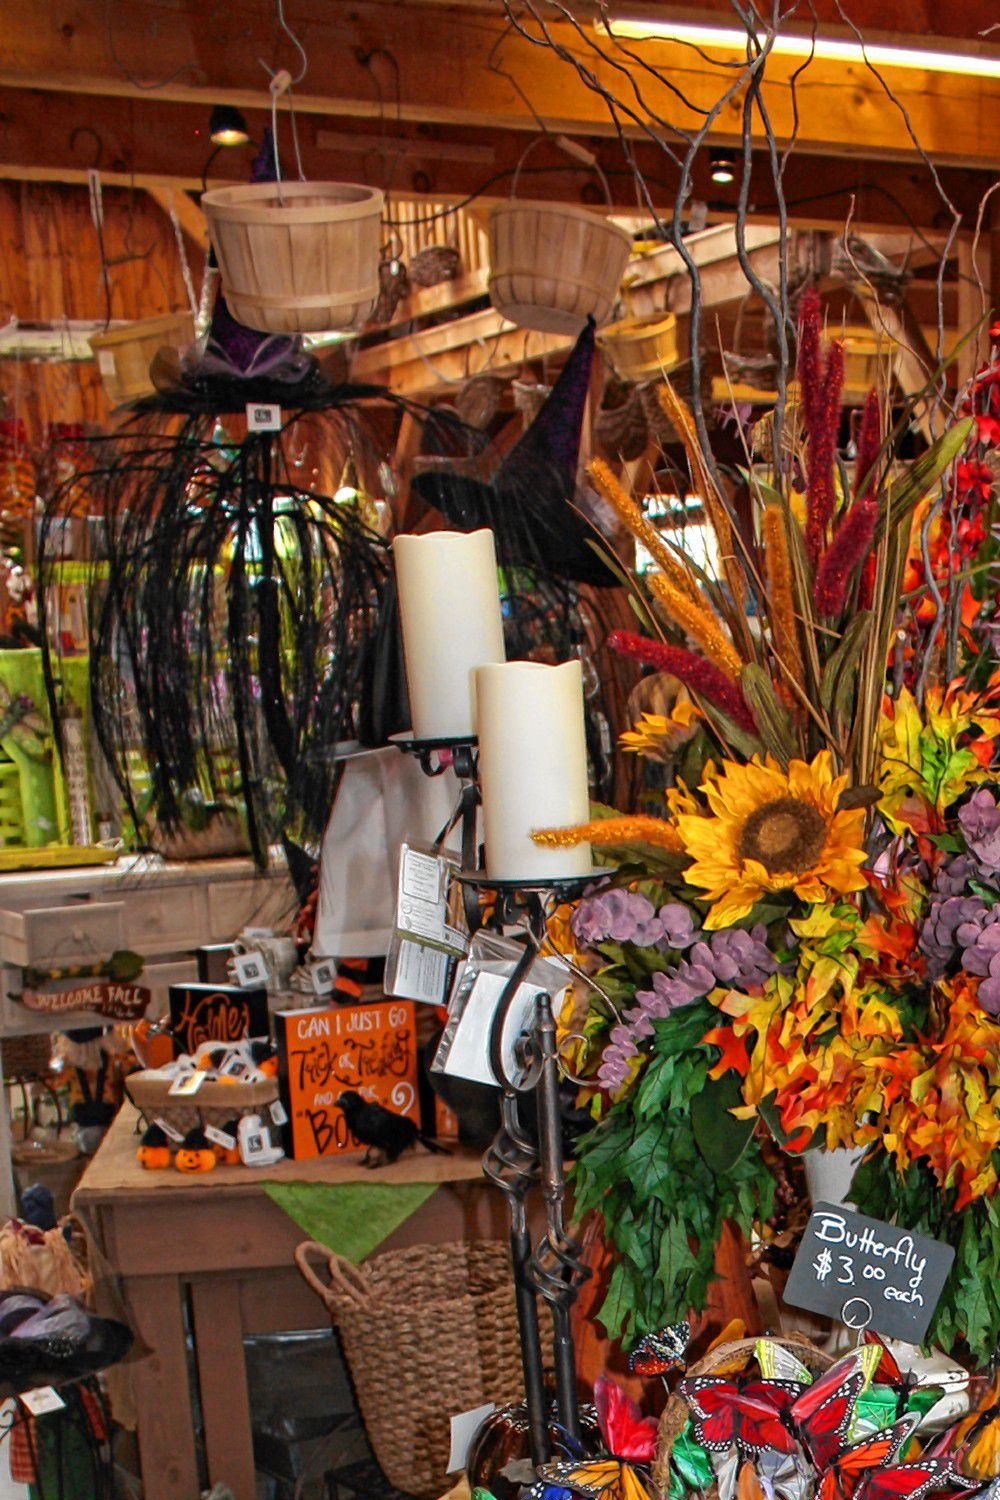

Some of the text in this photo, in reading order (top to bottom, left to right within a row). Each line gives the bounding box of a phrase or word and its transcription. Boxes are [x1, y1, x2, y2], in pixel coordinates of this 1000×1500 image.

[37, 985, 103, 1010] WELCOME
[107, 985, 143, 1006] FALL
[297, 1006, 408, 1040] CAN I JUST GO
[290, 1040, 338, 1090] Trick
[812, 1212, 927, 1289] Butterfly
[883, 1286, 924, 1307] each
